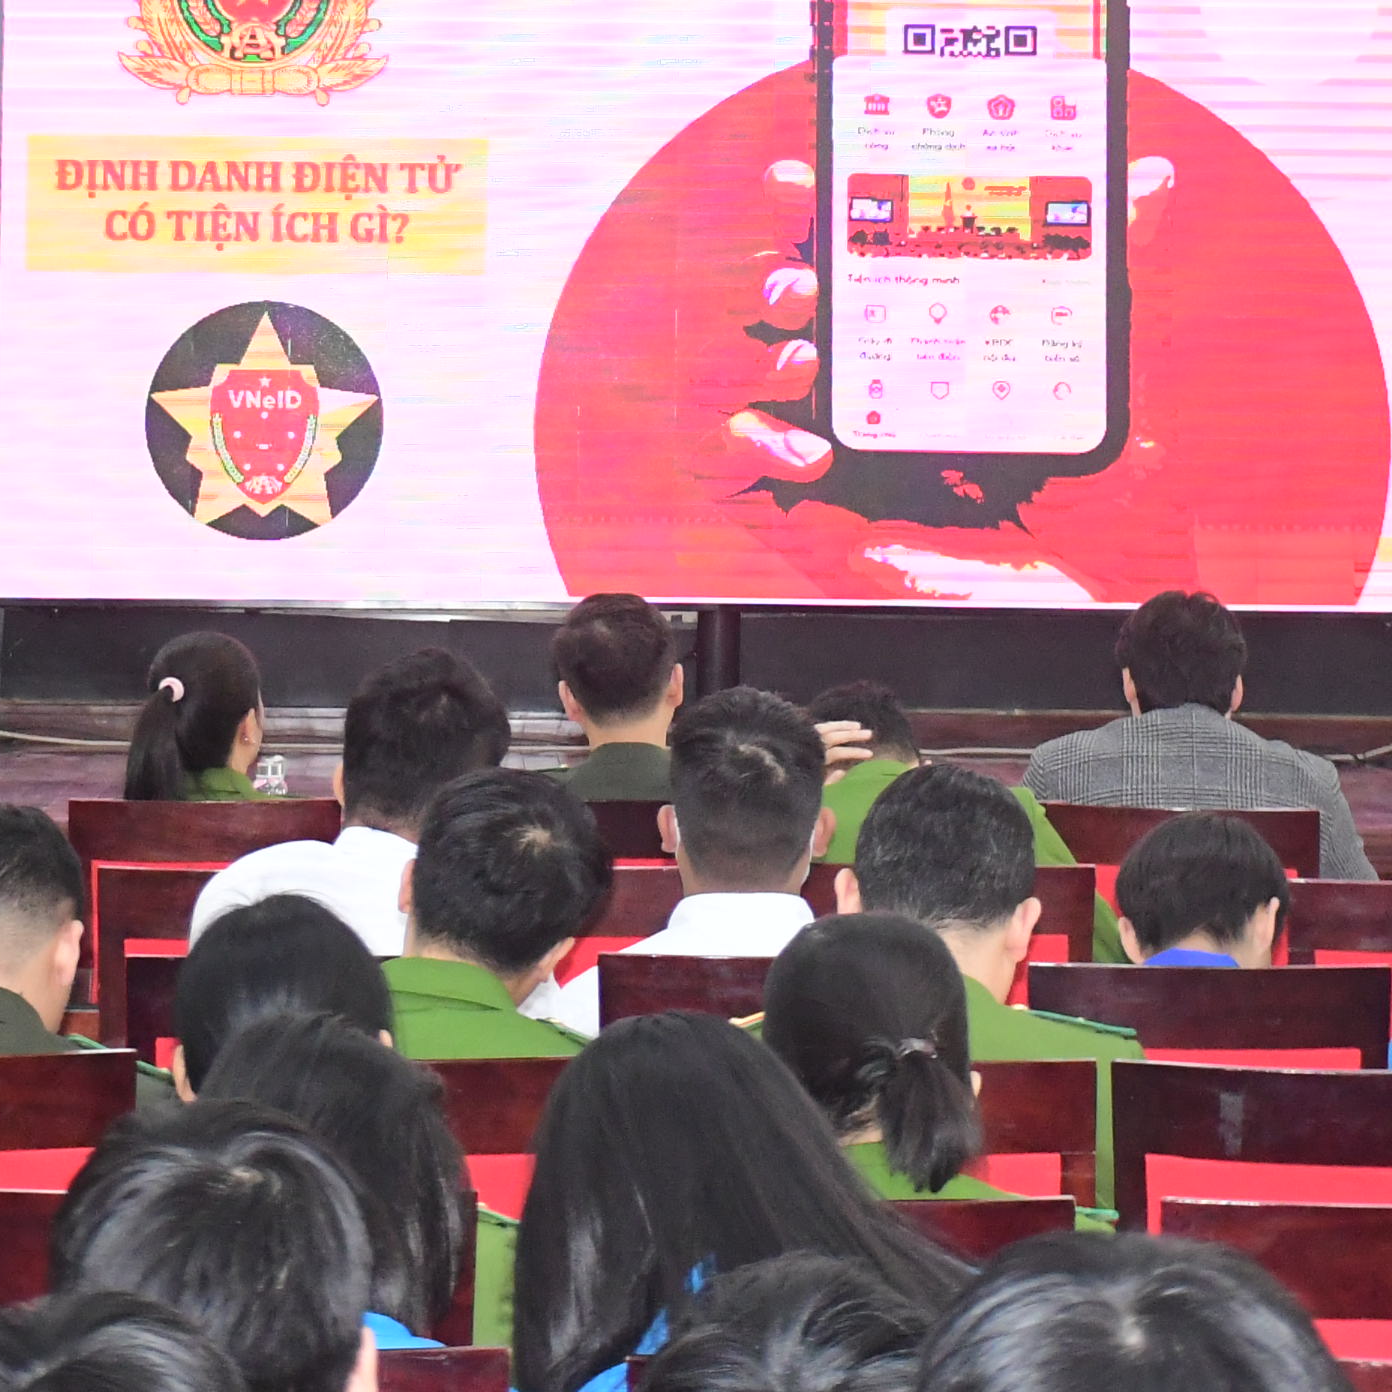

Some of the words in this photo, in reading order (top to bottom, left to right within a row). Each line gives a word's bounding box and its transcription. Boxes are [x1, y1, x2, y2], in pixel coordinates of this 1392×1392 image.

[55, 159, 159, 199] ĐỊNH
[169, 160, 282, 193] DANH
[292, 153, 389, 201] ĐIỆN
[399, 155, 463, 194] TỬ
[104, 202, 156, 242] CÓ
[166, 202, 260, 251] TIỆN
[270, 203, 339, 243] ÍCH
[349, 204, 410, 245] GÌ?
[227, 390, 302, 409] VNeID
